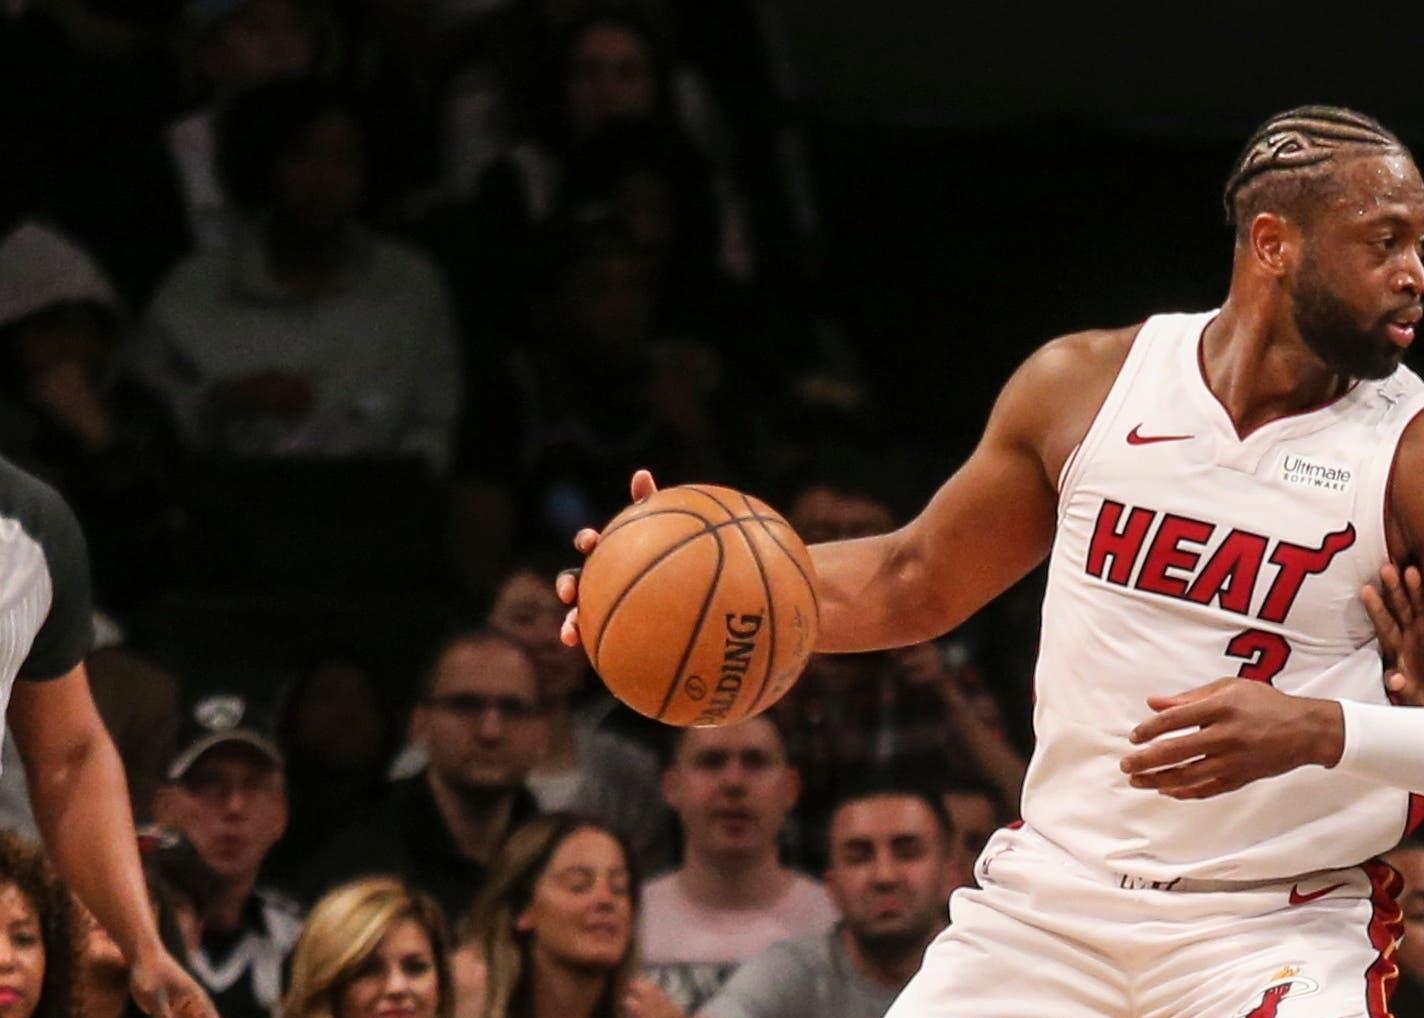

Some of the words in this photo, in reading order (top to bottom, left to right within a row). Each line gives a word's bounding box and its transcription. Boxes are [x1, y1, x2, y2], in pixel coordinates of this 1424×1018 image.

[1283, 455, 1351, 482] Ultimate
[1283, 472, 1345, 492] SOFTWARE
[1085, 498, 1357, 624] HEAT
[694, 612, 763, 725] PALDING
